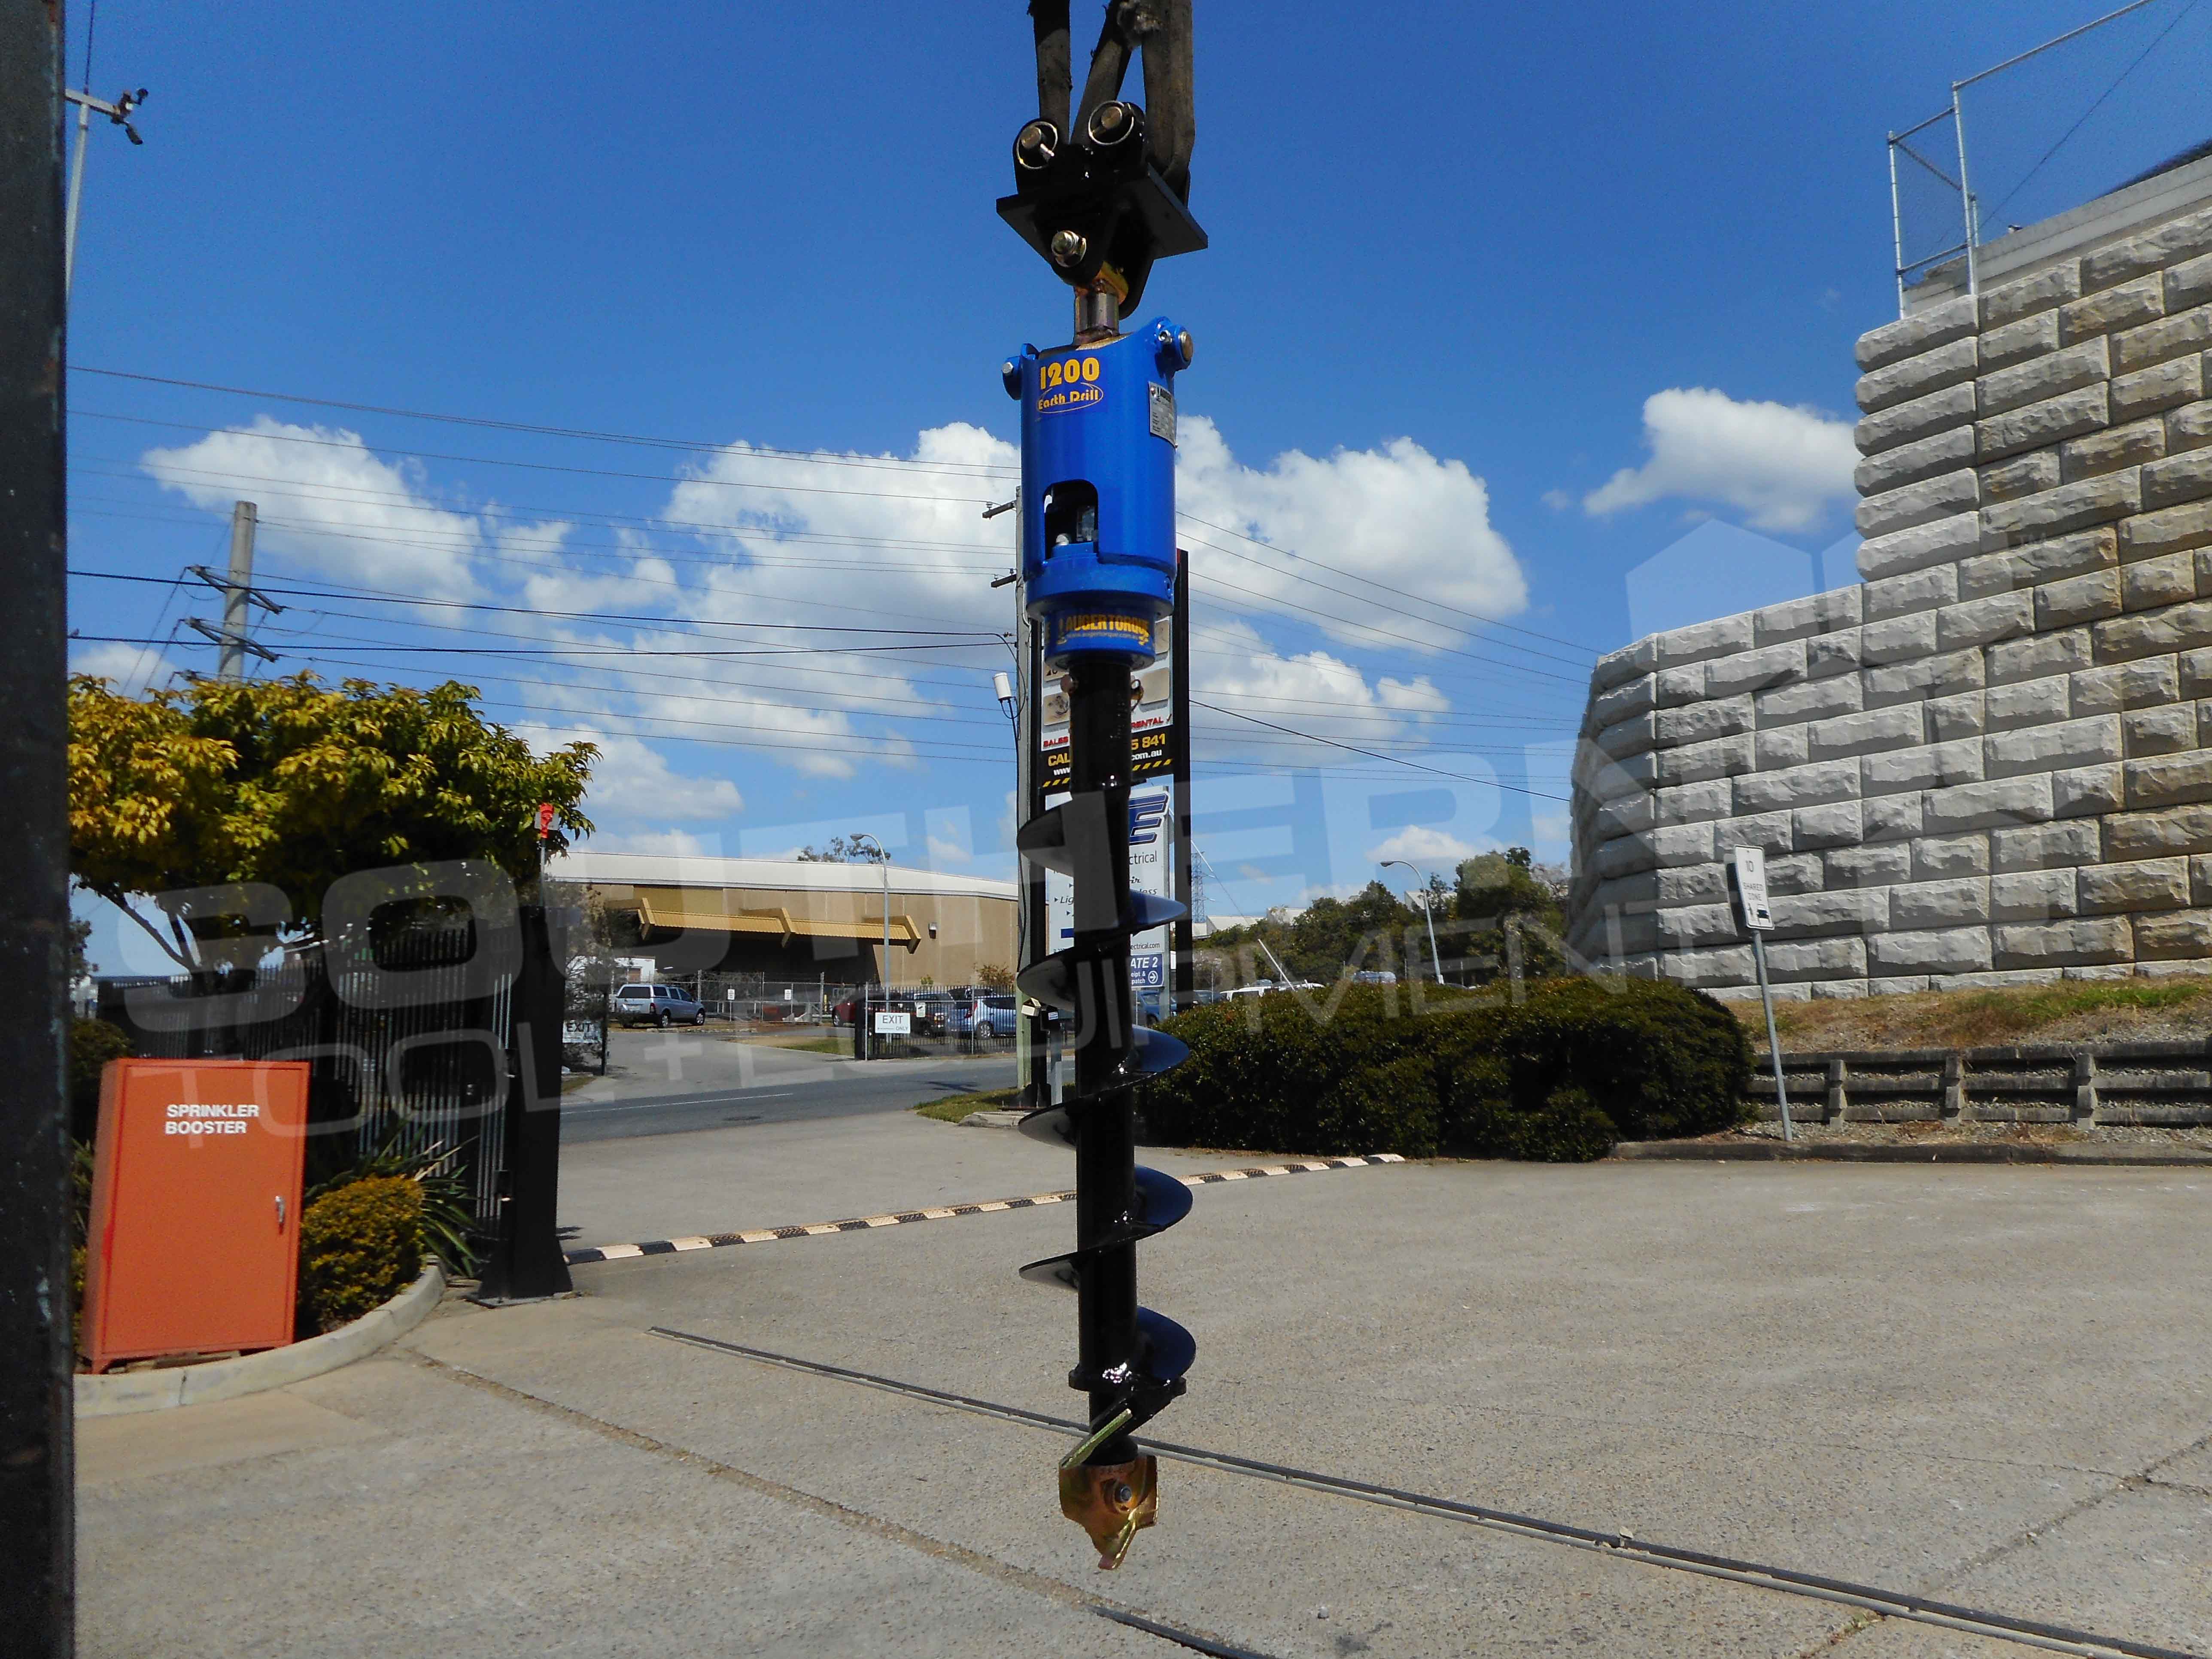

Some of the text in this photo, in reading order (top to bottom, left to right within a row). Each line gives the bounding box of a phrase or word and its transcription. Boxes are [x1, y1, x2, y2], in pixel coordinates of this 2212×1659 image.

[1041, 357, 1100, 389] 1200
[1038, 389, 1098, 410] Earth Drill
[1142, 733, 1165, 748] 841
[1152, 957, 1158, 968] 2
[882, 1015, 903, 1024] EXIT
[167, 1104, 259, 1117] SPRINKLER
[165, 1121, 247, 1134] BOOSTER
